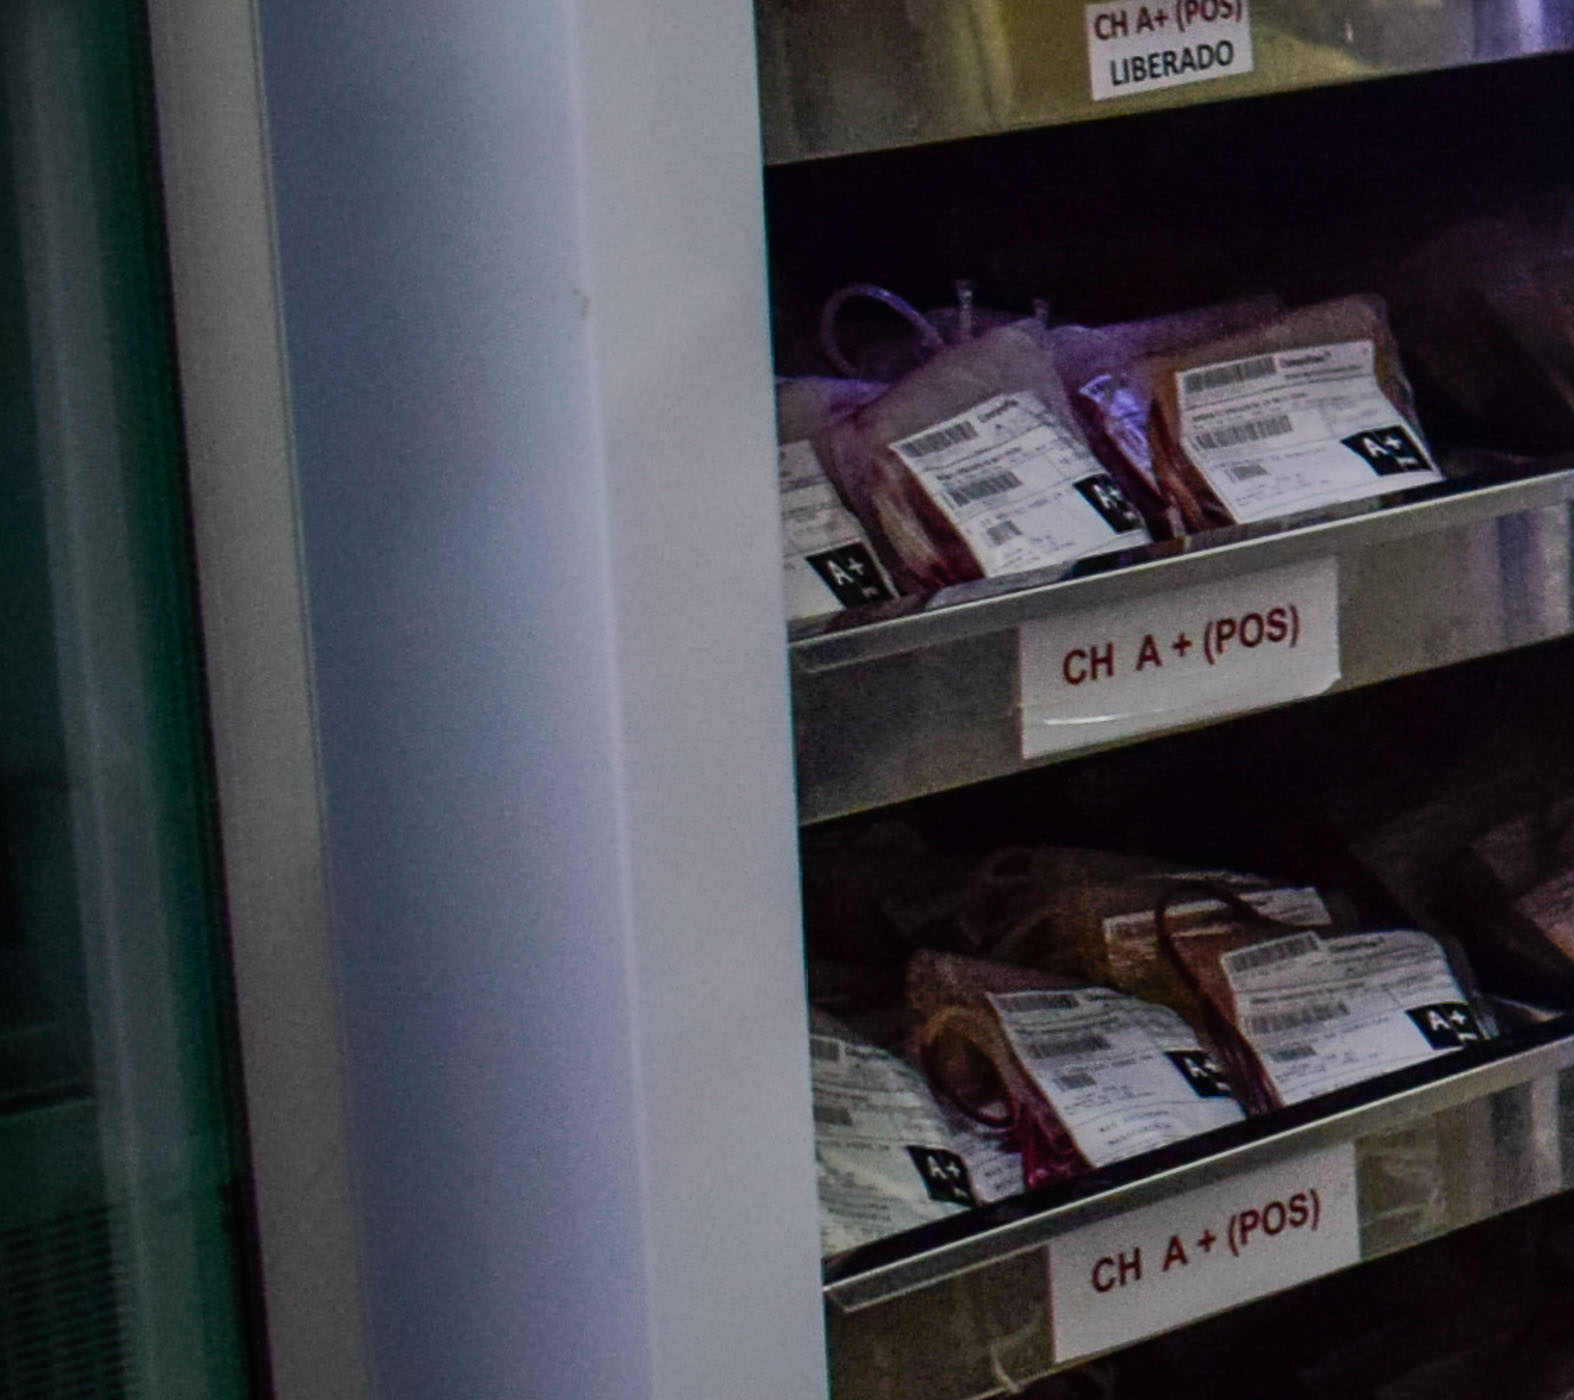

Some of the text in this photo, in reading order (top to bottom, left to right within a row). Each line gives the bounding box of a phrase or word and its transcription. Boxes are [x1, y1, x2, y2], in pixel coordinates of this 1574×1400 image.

[1094, 7, 1129, 41] CH
[1135, 3, 1169, 35] A+
[1109, 40, 1235, 86] LIBERADO
[1360, 434, 1405, 459] A+
[825, 556, 866, 588] A+
[1062, 640, 1116, 686] CH
[1134, 631, 1163, 673] A
[1202, 604, 1302, 668] (POS)
[1426, 1009, 1468, 1032] A+
[1092, 1255, 1143, 1295] CH
[1163, 1234, 1190, 1271] A
[1227, 1188, 1323, 1260] (POS)
